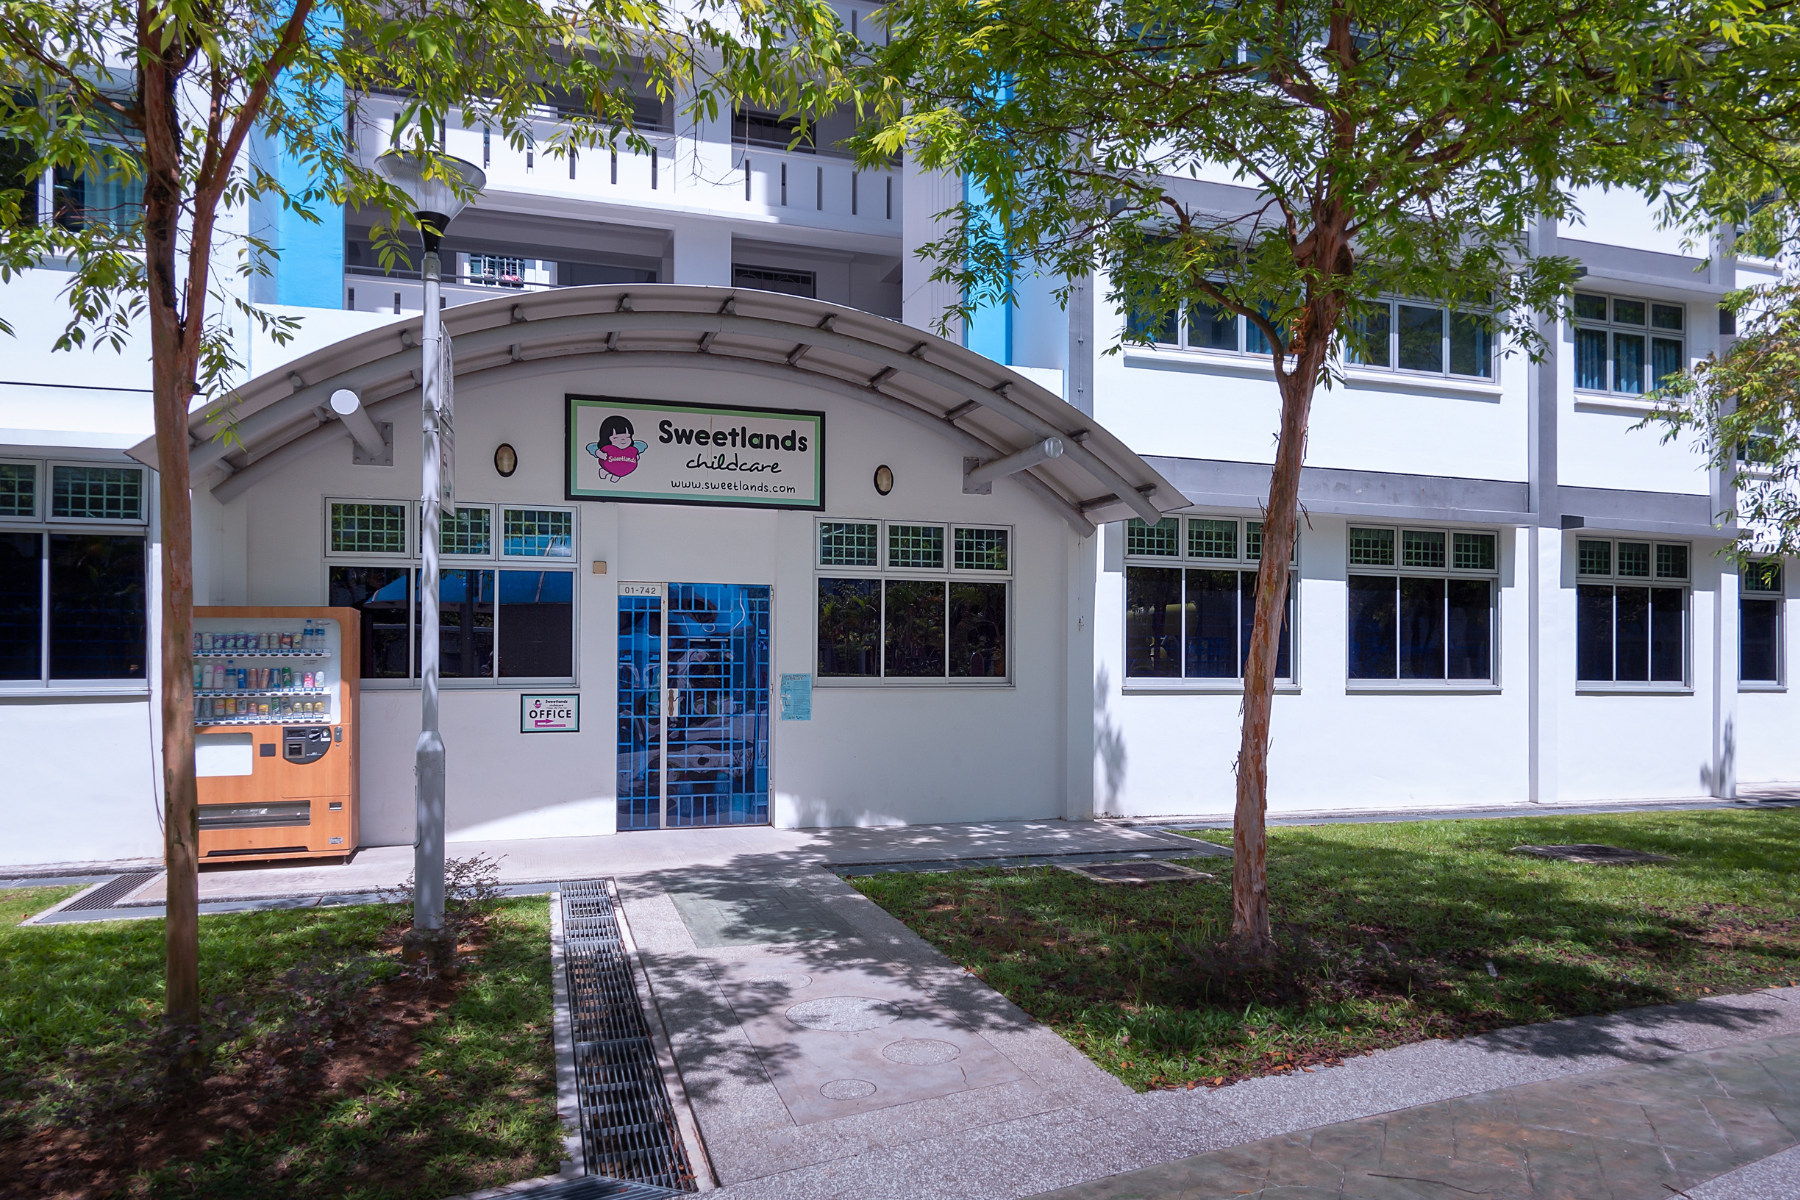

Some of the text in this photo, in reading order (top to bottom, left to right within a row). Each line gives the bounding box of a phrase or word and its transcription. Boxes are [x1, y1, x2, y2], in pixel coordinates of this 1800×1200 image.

[659, 419, 808, 452] Sweetlands
[686, 453, 782, 474] childcare
[671, 480, 796, 494] www.sweetlands.com
[624, 586, 656, 595] 01-742
[529, 709, 572, 719] OFFICE
